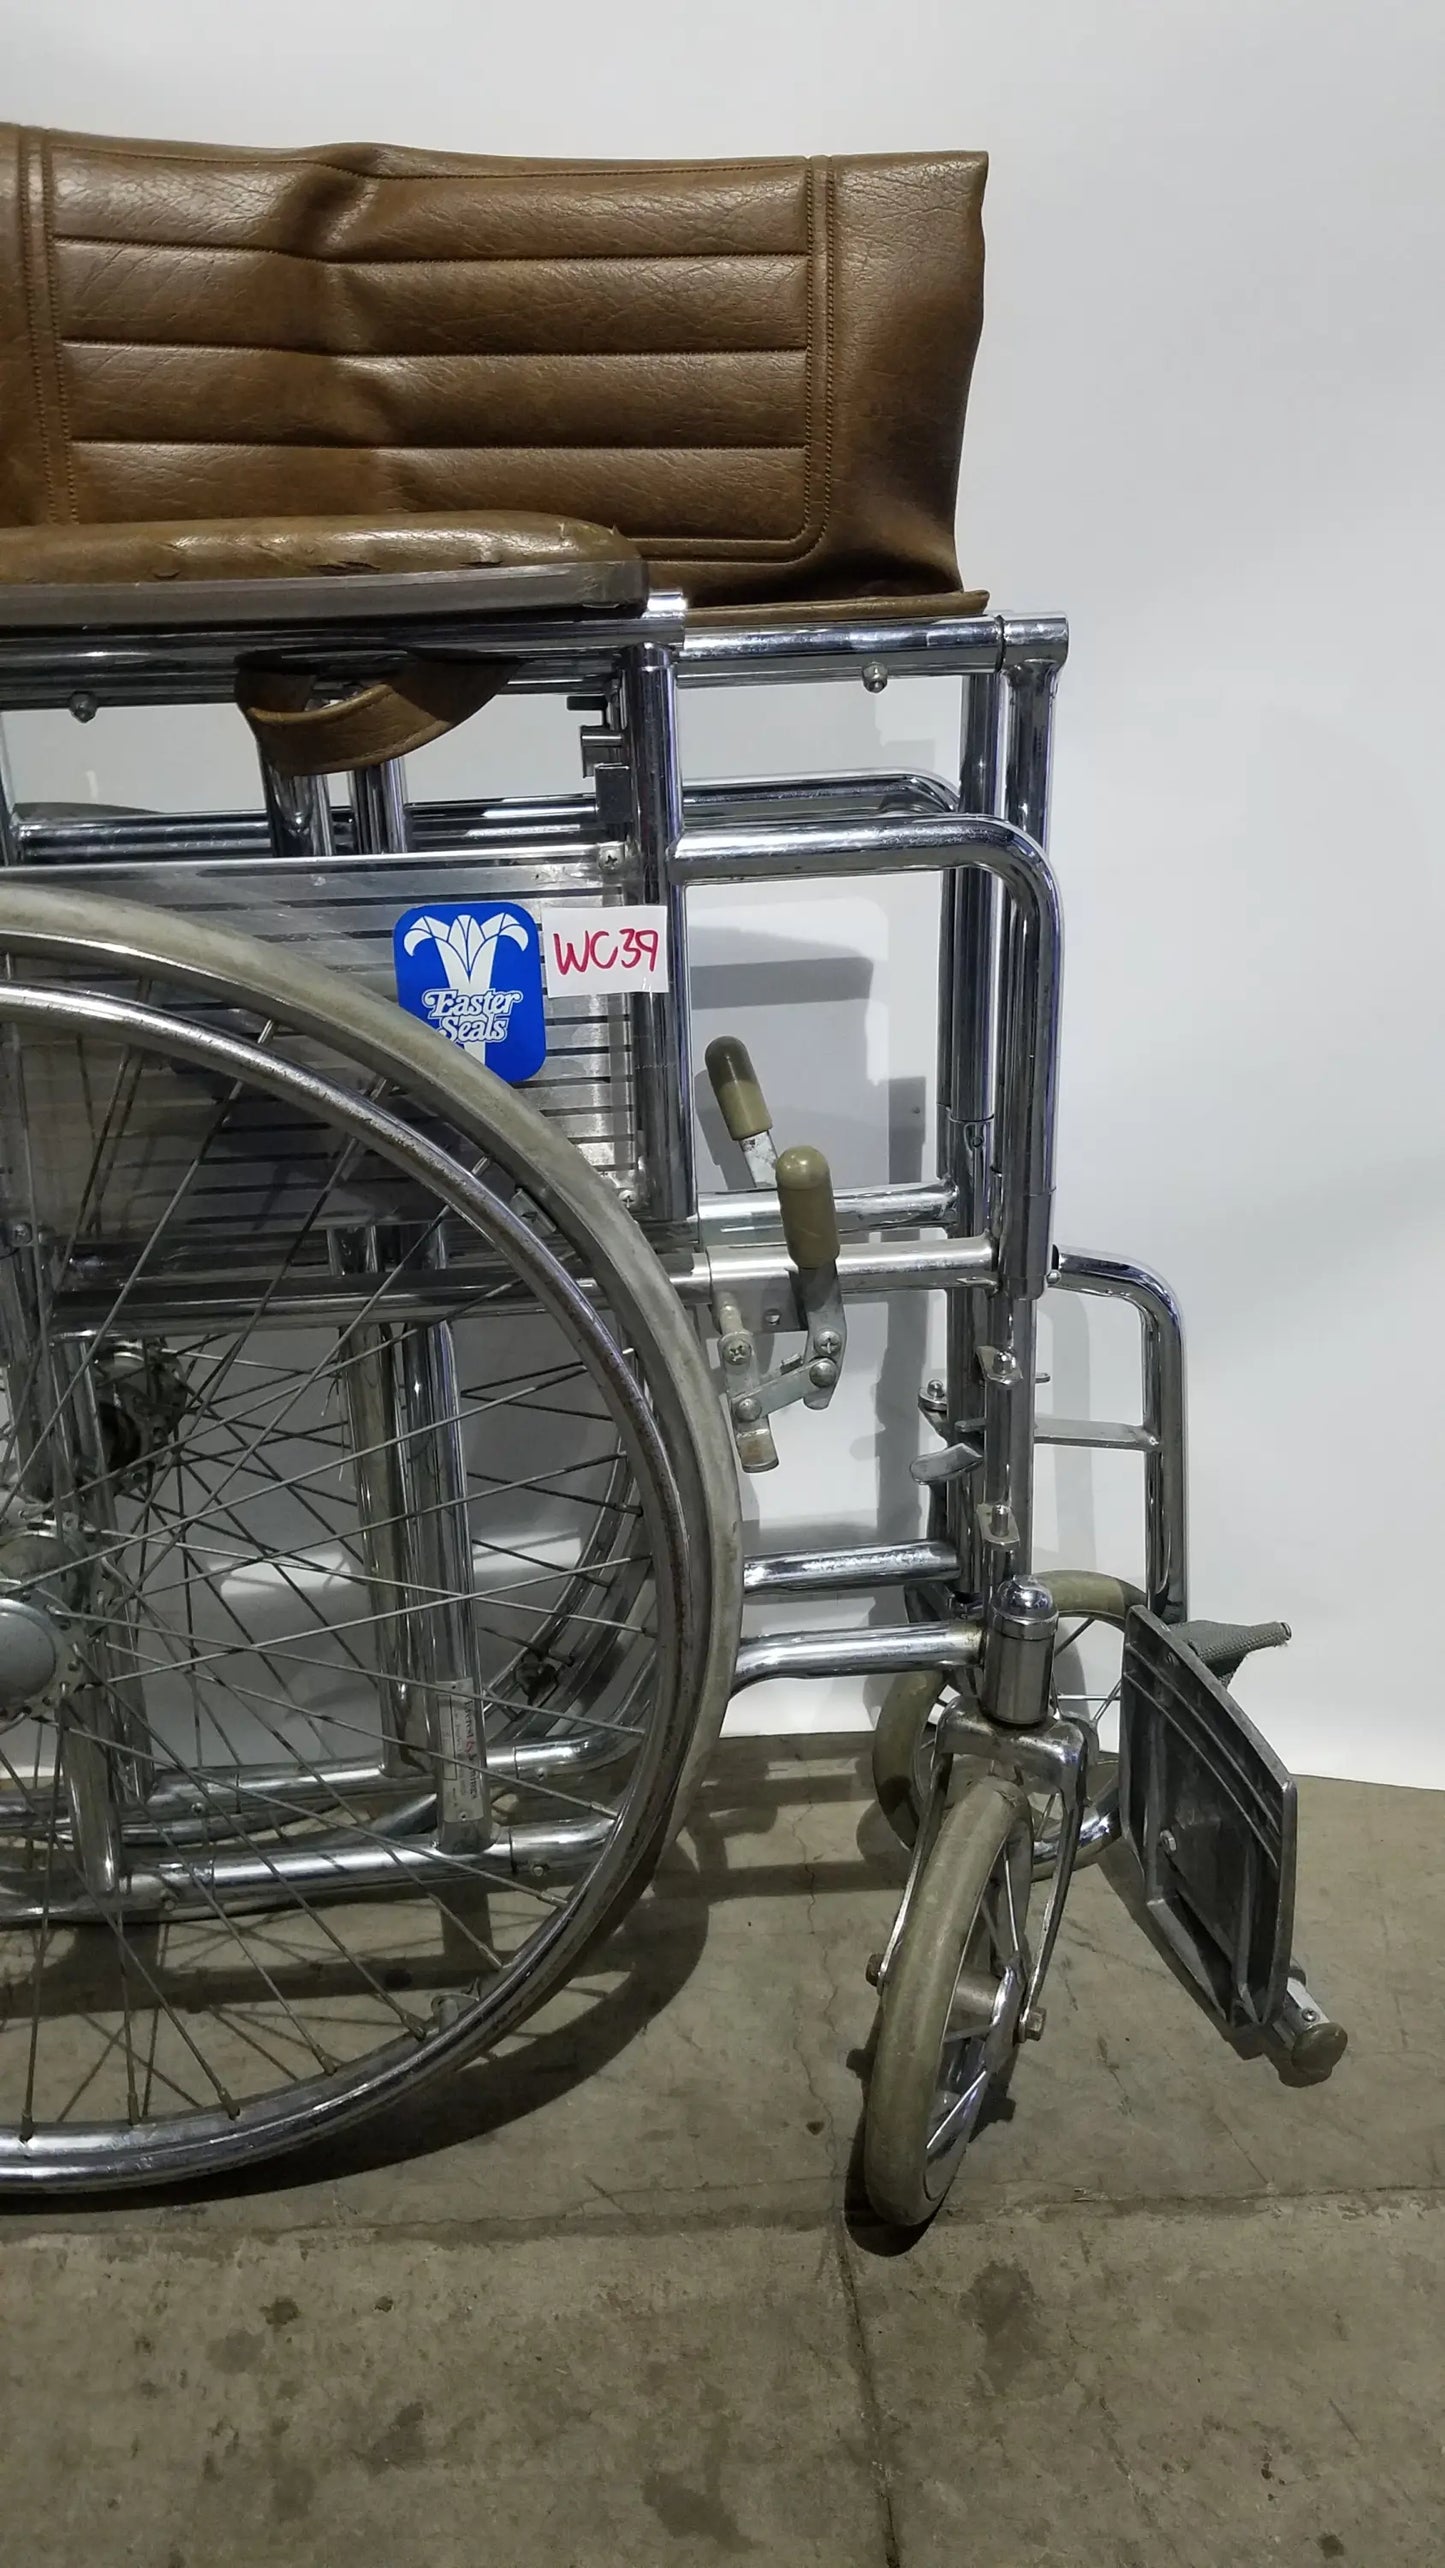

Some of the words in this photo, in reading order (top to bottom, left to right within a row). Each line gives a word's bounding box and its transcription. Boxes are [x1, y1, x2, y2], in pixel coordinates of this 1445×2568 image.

[553, 928, 659, 976] WC39
[423, 988, 523, 1018] Easter
[439, 1015, 507, 1042] Seals
